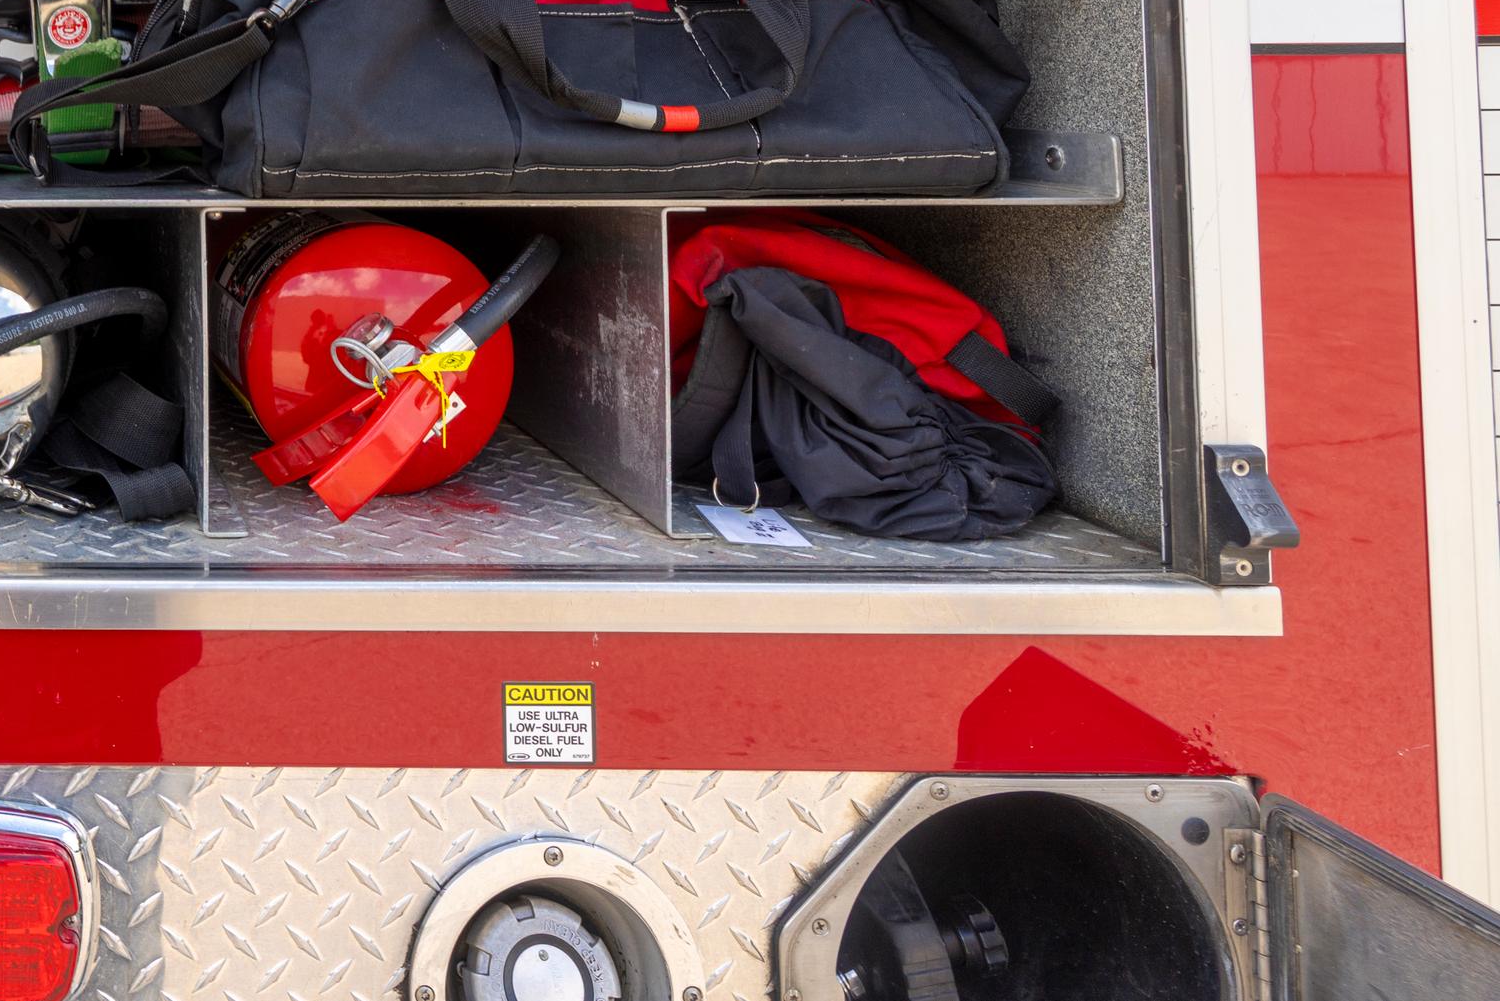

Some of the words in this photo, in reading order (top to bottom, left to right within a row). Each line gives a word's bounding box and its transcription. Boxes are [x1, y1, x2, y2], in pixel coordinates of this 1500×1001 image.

[29, 313, 54, 330] TESTED
[54, 310, 63, 320] TO
[508, 688, 589, 701] CAUTION
[518, 711, 540, 721] USE
[545, 711, 579, 721] ULTRA
[509, 723, 588, 733] LOW-SULFUR
[514, 736, 553, 745] DIESEL
[557, 736, 585, 745] FUEL
[535, 748, 563, 758] ONLY
[543, 920, 581, 946] CLEAN
[581, 948, 604, 982] KEEP
